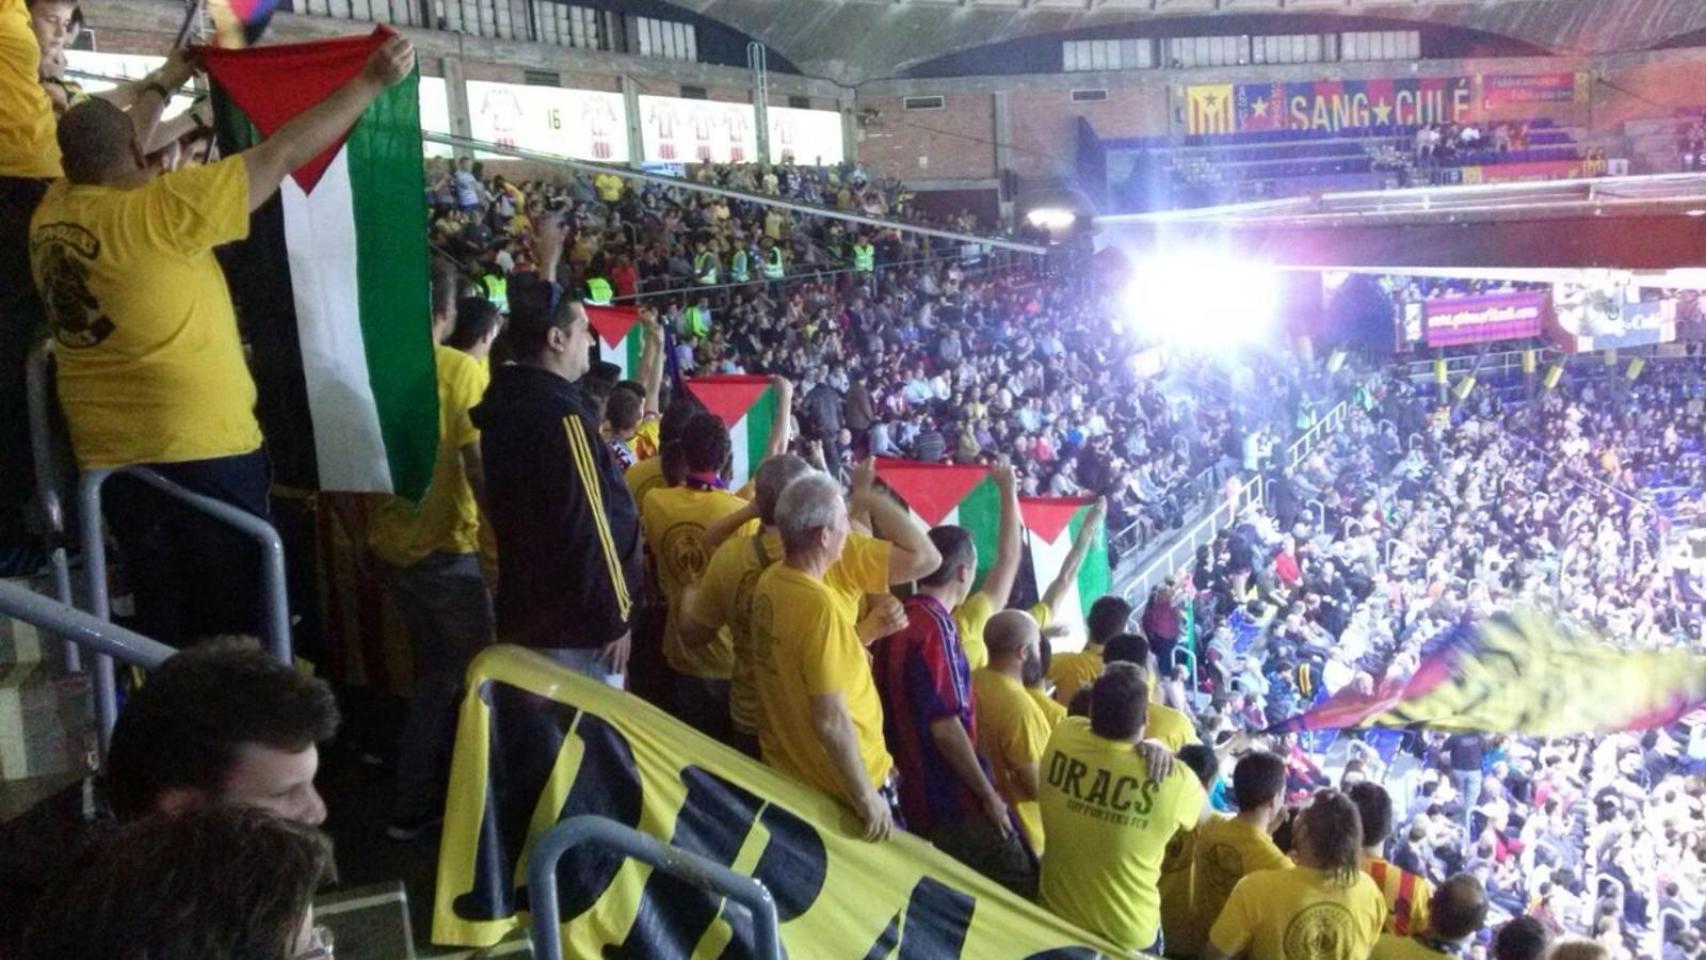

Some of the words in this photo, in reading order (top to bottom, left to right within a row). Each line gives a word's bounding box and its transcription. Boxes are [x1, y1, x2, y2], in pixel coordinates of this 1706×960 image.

[547, 108, 561, 130] 16
[1291, 91, 1370, 132] SANG
[1396, 79, 1469, 126] CULÉ
[1047, 749, 1160, 815] DRACS
